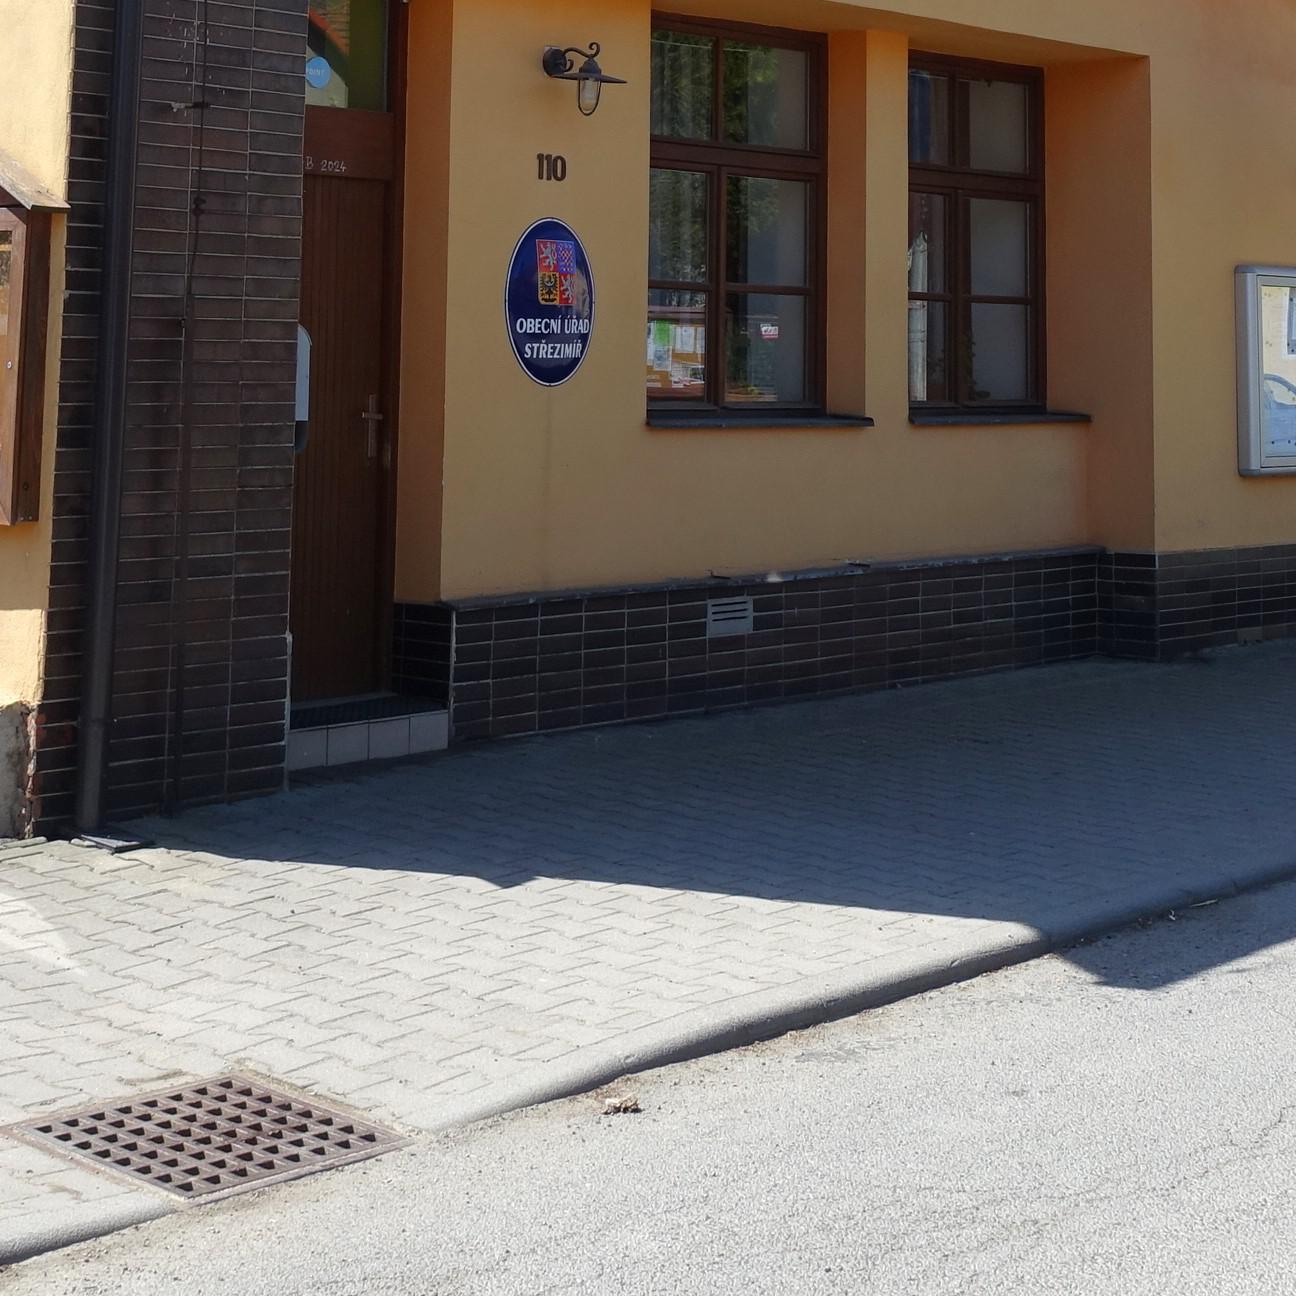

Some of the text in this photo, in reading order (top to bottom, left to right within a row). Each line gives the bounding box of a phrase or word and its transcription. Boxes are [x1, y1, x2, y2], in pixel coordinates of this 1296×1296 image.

[320, 160, 347, 172] 2024
[536, 153, 567, 181] 110
[516, 313, 590, 334] OBECNÍ ÚŘAD
[524, 339, 582, 359] STŘEZIMÍŘ
